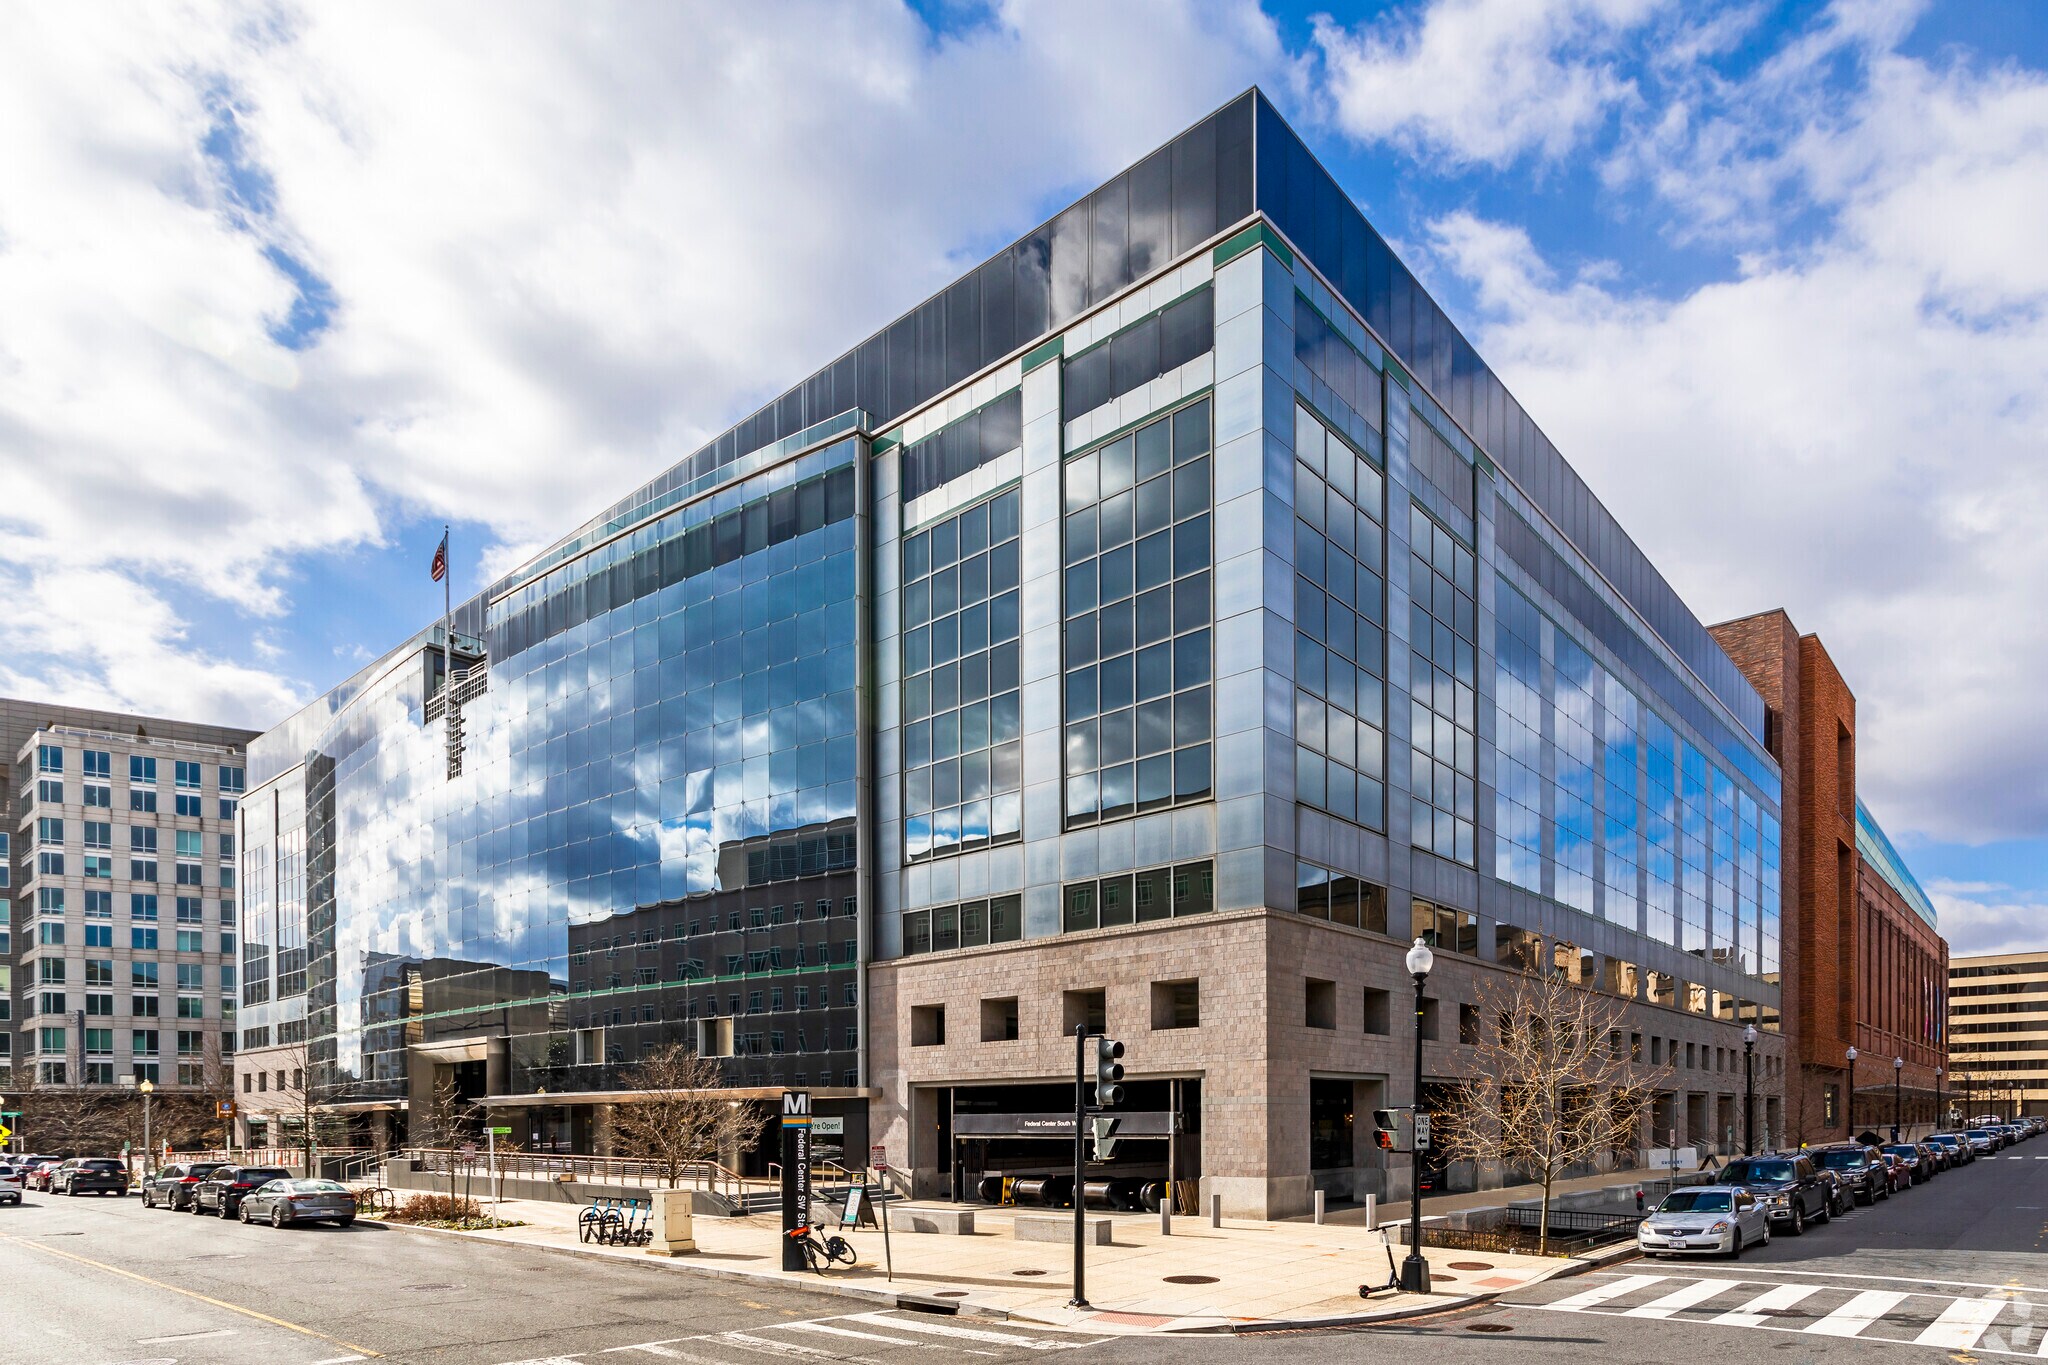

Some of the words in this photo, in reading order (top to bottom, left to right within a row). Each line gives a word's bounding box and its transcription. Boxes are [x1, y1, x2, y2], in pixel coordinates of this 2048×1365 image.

[784, 1094, 806, 1114] M
[821, 1122, 841, 1131] Open!
[1418, 1117, 1428, 1125] ONE
[1417, 1127, 1429, 1135] WAY
[798, 1128, 806, 1160] Federal
[798, 1163, 806, 1191] Center
[798, 1195, 806, 1209] SW
